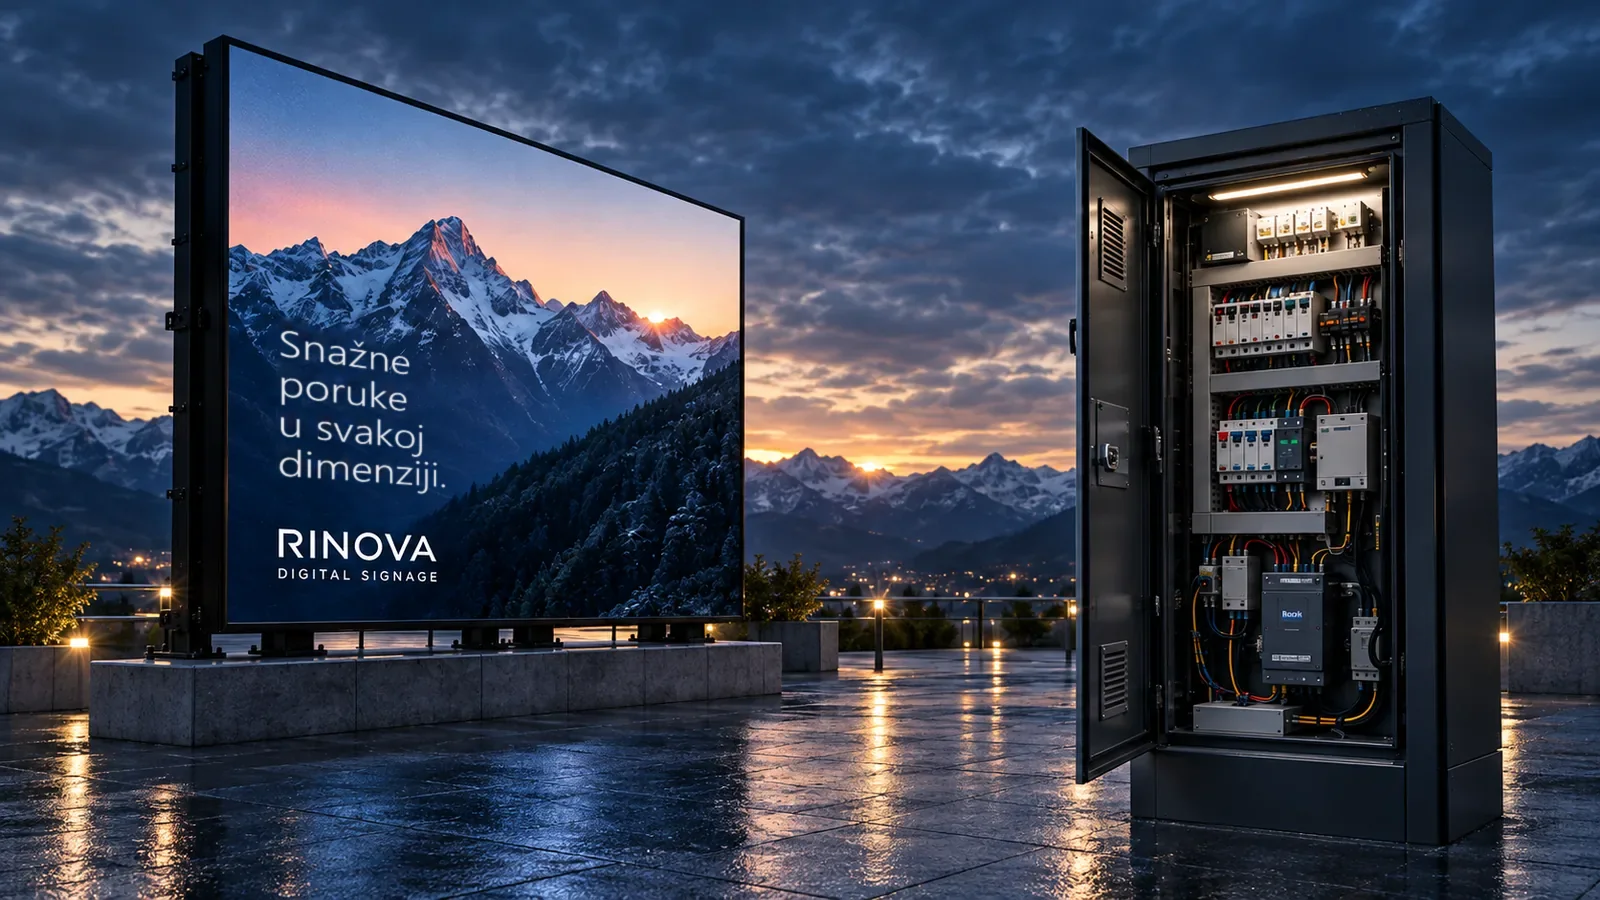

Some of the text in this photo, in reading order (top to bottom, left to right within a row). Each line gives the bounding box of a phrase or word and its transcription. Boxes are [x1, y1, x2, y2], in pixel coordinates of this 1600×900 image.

[280, 330, 410, 375] Snažne
[280, 376, 407, 412] poruke
[280, 416, 423, 458] u svakoj
[279, 449, 446, 495] dimenziji.
[278, 528, 437, 562] RINOVA
[278, 567, 437, 582] DIGITAL SIGNAGE
